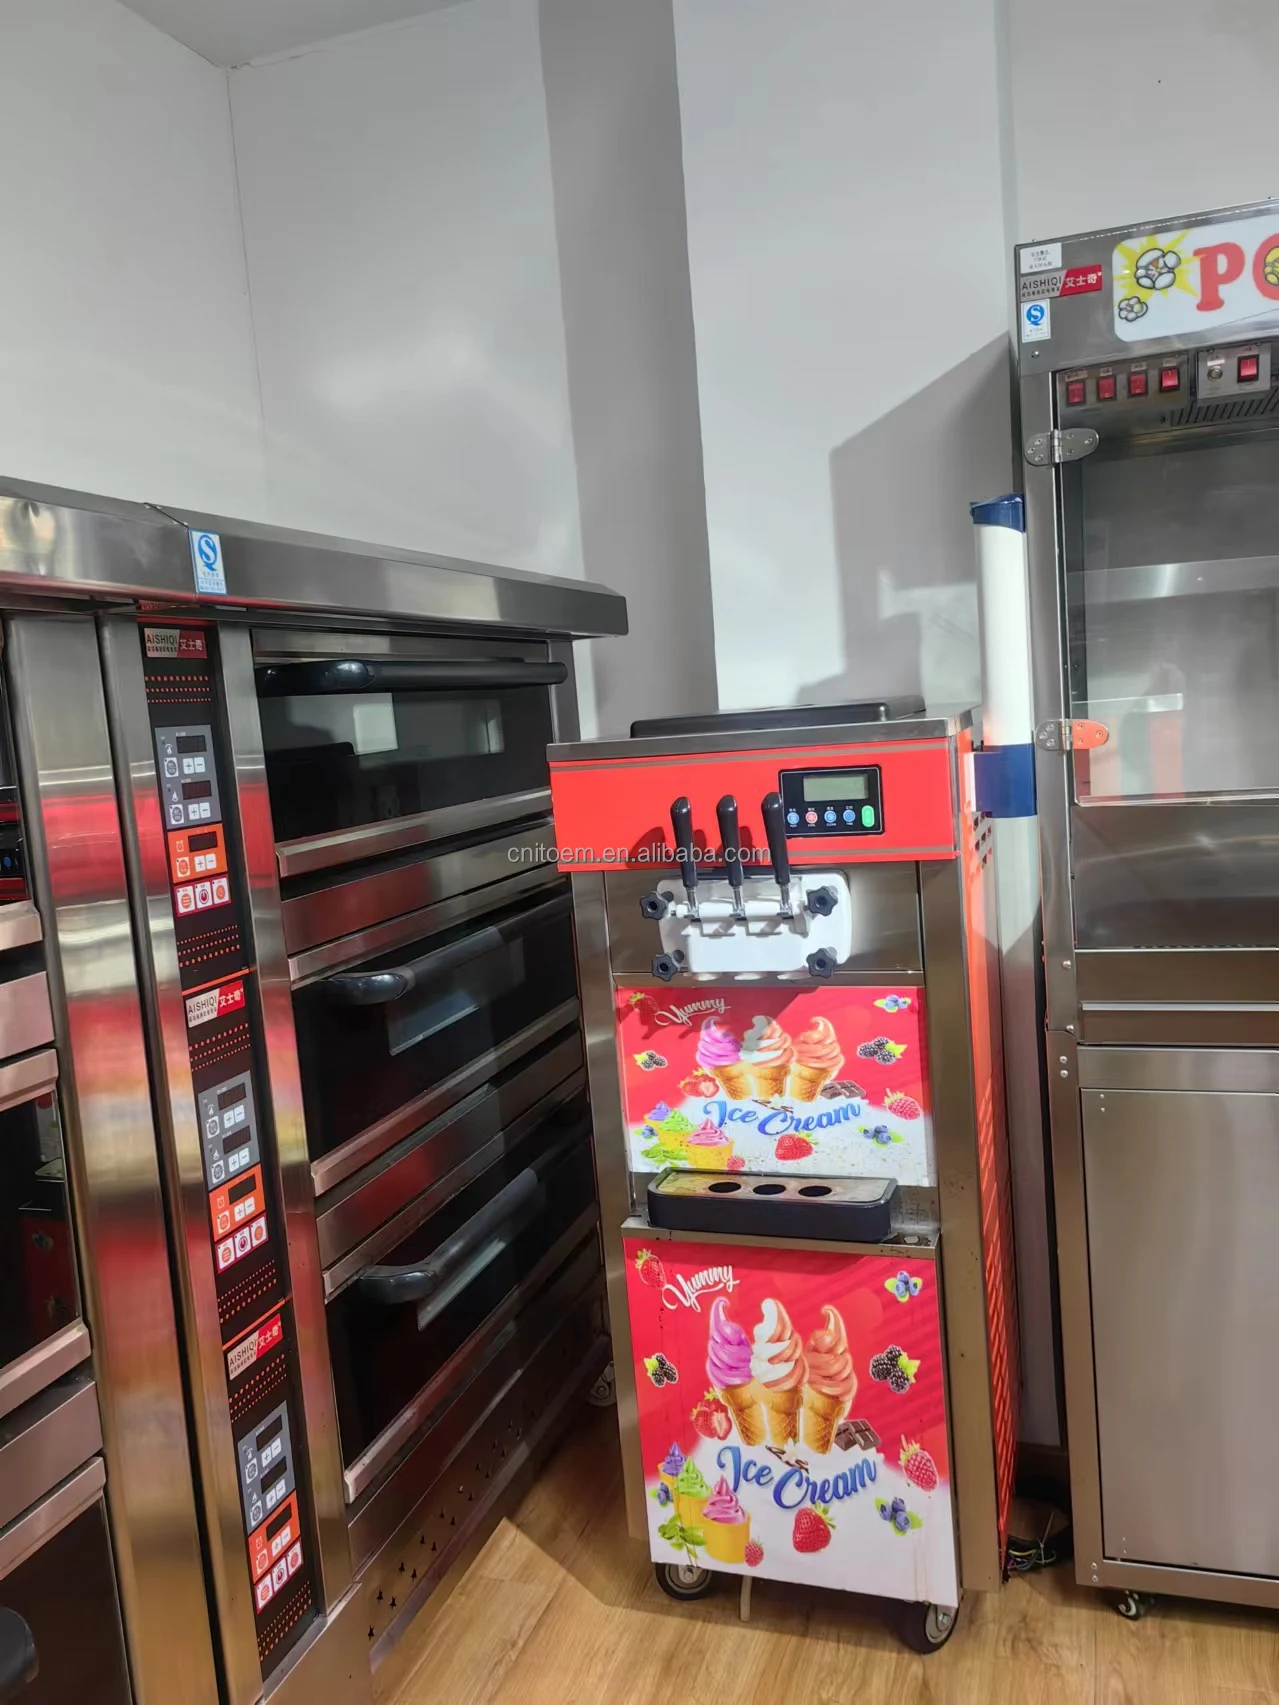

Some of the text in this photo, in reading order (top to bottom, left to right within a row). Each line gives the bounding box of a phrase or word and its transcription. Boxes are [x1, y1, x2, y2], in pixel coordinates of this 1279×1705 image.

[1021, 276, 1062, 291] AISHIQI
[1065, 273, 1098, 289] 艾士奇
[146, 634, 178, 646] AISHIQI
[188, 995, 217, 1015] AISHIQI
[218, 989, 241, 1008] 艾士奇
[654, 996, 732, 1028] Yummy
[703, 1100, 861, 1136] Ice Cream
[662, 1264, 740, 1313] Yummy
[229, 1340, 257, 1368] AISHIQI
[716, 1445, 877, 1510] Ice Cream
